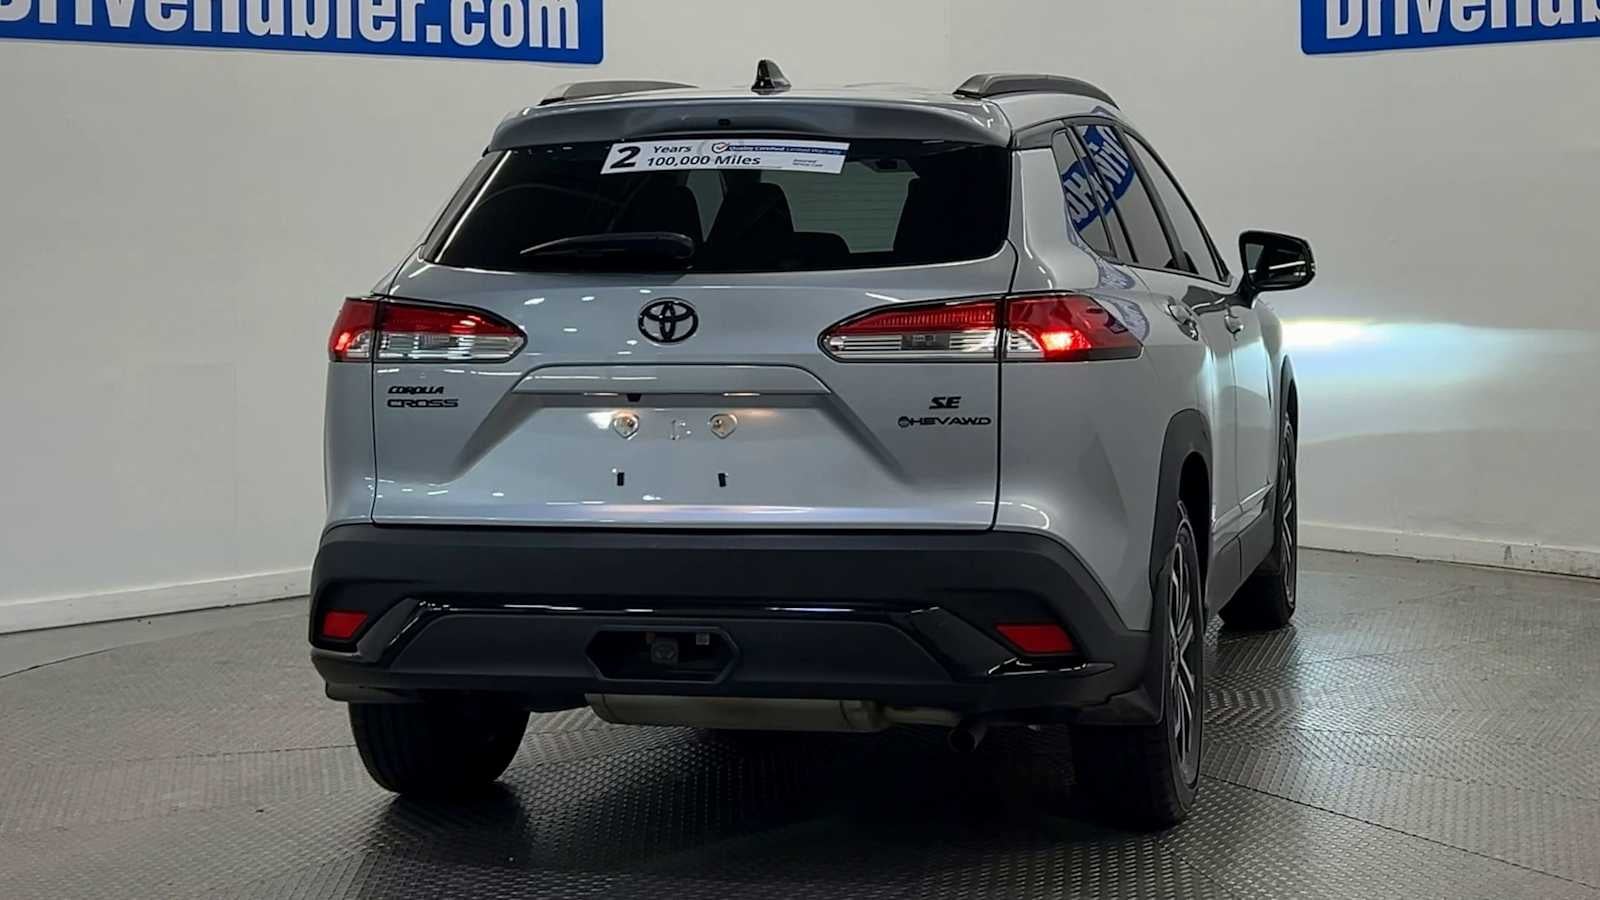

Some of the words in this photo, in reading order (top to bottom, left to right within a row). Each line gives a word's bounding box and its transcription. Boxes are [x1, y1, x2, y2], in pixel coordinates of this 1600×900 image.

[0, 0, 579, 49] veubler.com
[1326, 0, 1600, 39] Drveu
[653, 145, 692, 154] Years
[609, 145, 640, 169] 2
[647, 155, 710, 167] 100,000
[714, 154, 761, 166] Miles
[387, 385, 445, 395] COROLLA
[387, 398, 459, 408] CROSS
[929, 396, 962, 410] SE
